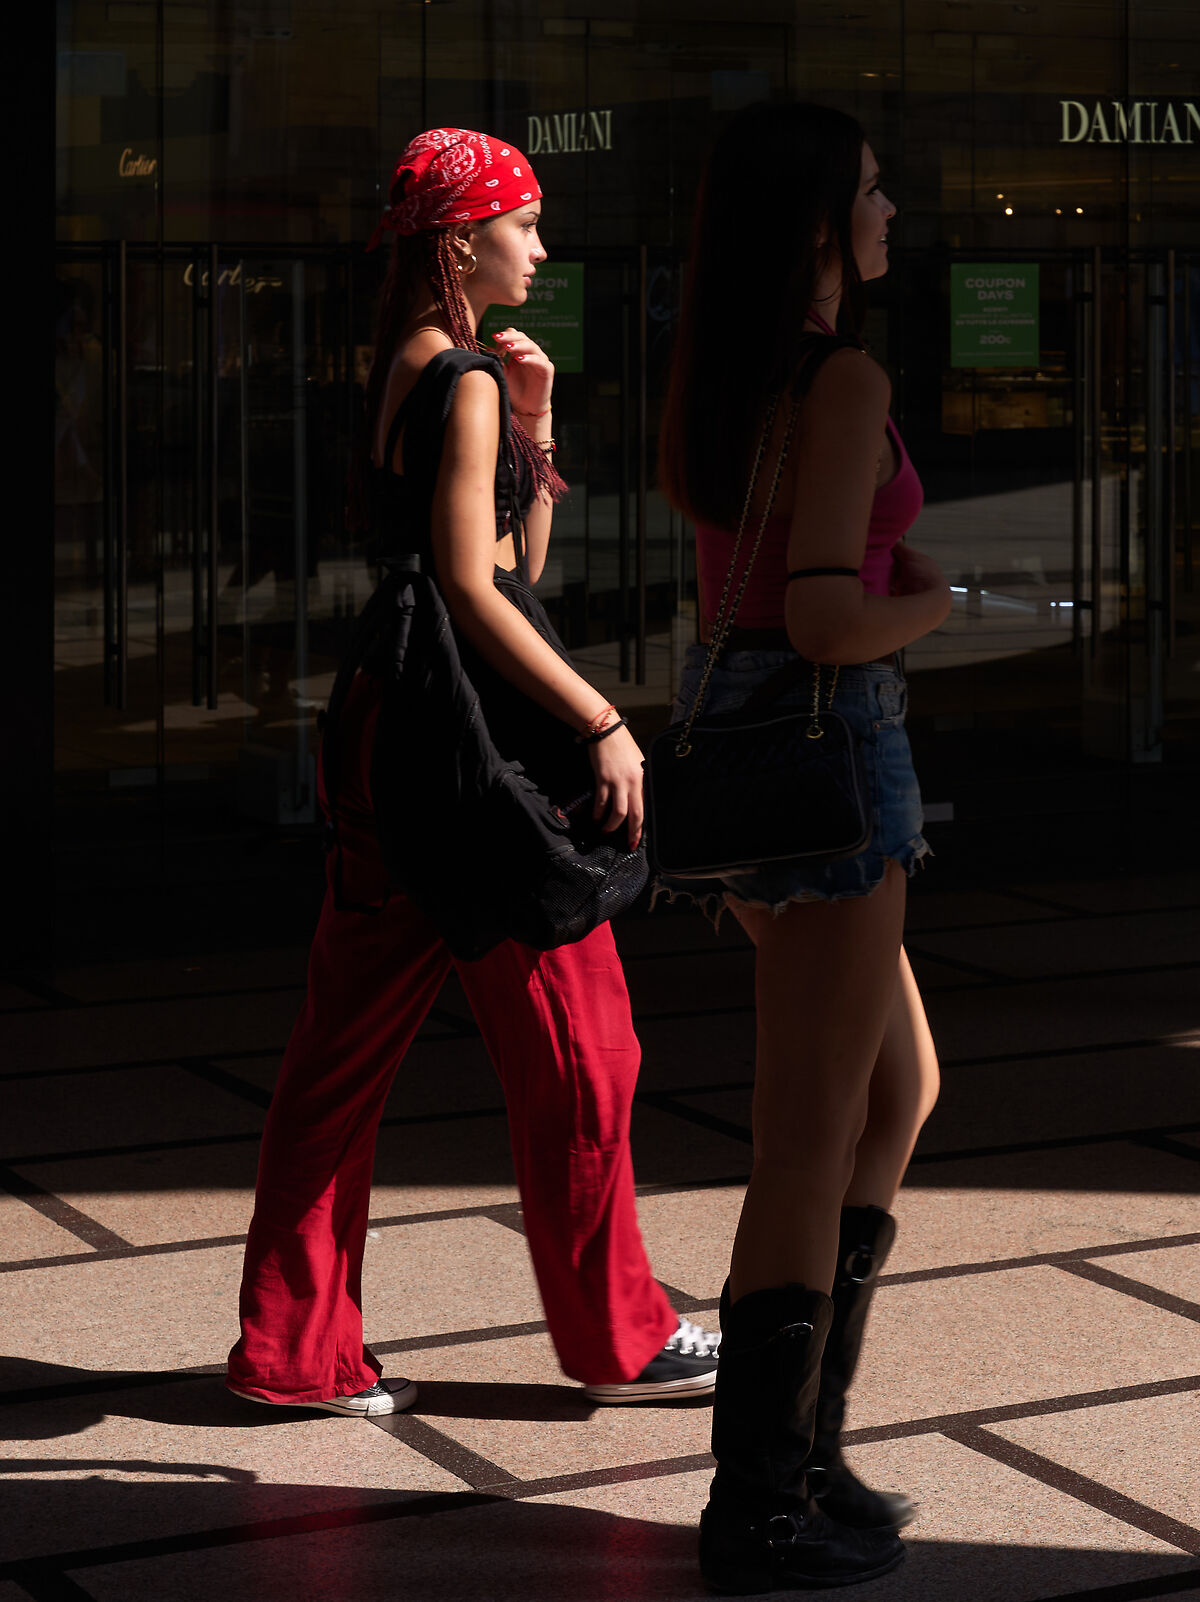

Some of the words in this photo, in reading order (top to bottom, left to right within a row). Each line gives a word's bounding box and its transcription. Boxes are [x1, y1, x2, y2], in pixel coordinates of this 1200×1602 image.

[527, 110, 613, 155] DAMIANI
[964, 277, 1027, 290] COUPON
[976, 289, 1015, 301] DAYS
